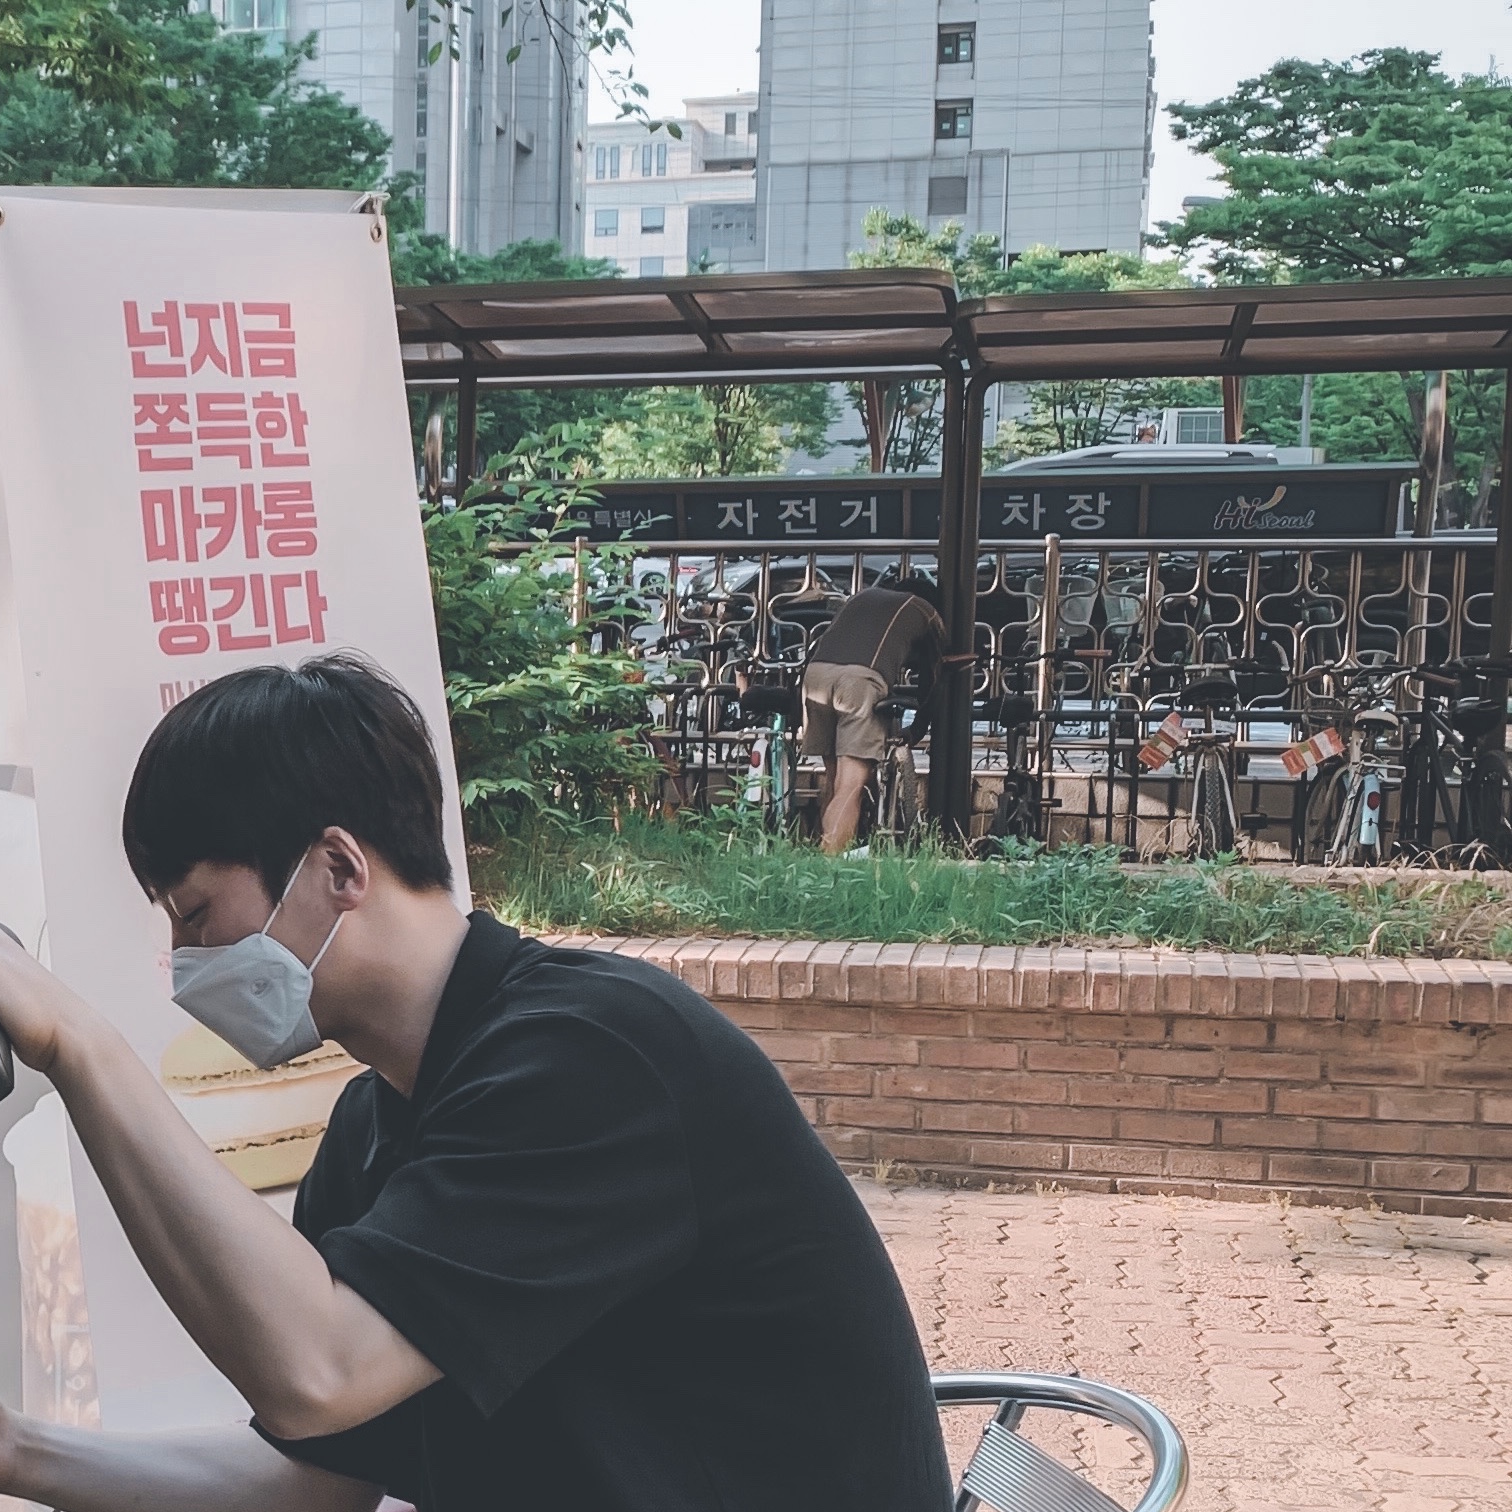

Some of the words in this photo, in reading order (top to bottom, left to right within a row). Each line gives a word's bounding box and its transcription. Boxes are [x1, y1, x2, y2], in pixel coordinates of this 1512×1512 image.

[123, 300, 298, 379] 넌지금
[133, 391, 311, 472] 쫀득한
[140, 480, 319, 563] 마카롱
[717, 496, 878, 535] 자전거
[149, 569, 329, 656] 땡긴다
